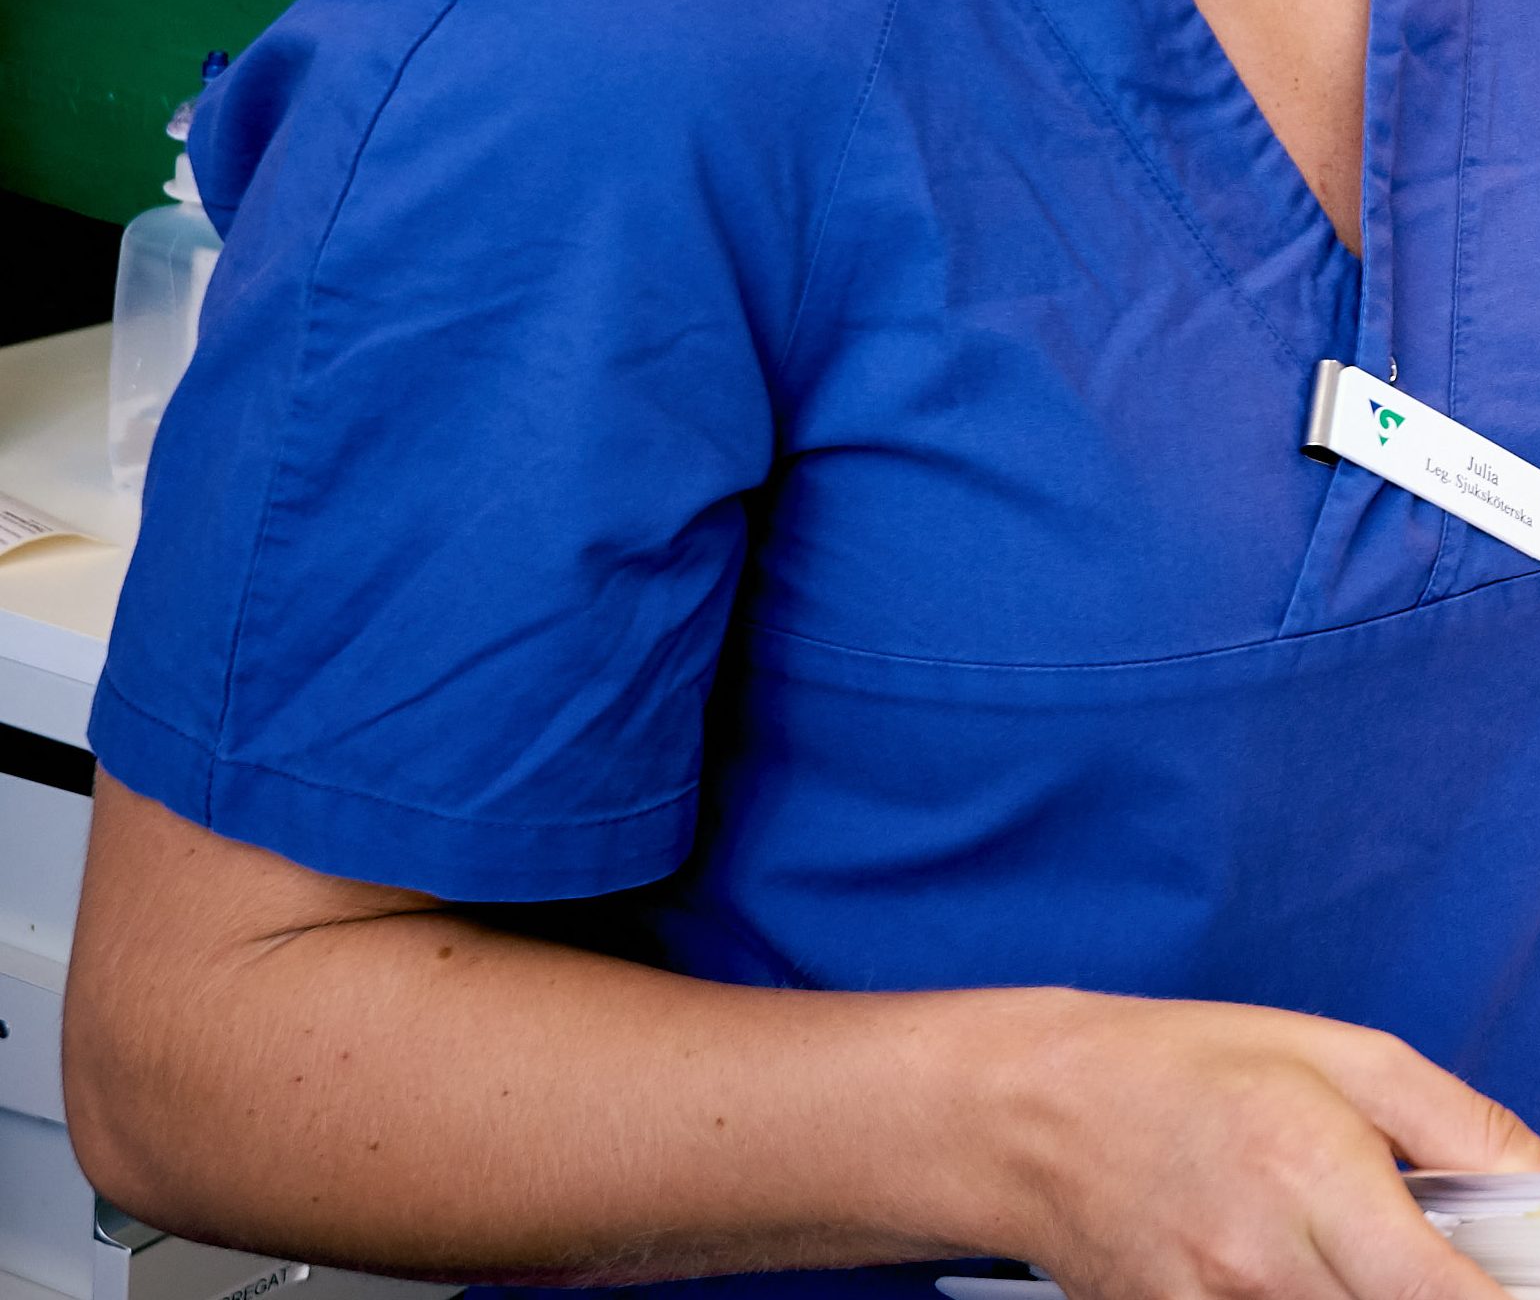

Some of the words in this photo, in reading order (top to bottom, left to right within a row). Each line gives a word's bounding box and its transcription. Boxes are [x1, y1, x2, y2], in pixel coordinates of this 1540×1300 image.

[1424, 458, 1452, 484] Leg.
[1454, 474, 1534, 528] Sjuksköterska
[1467, 456, 1499, 486] Julia
